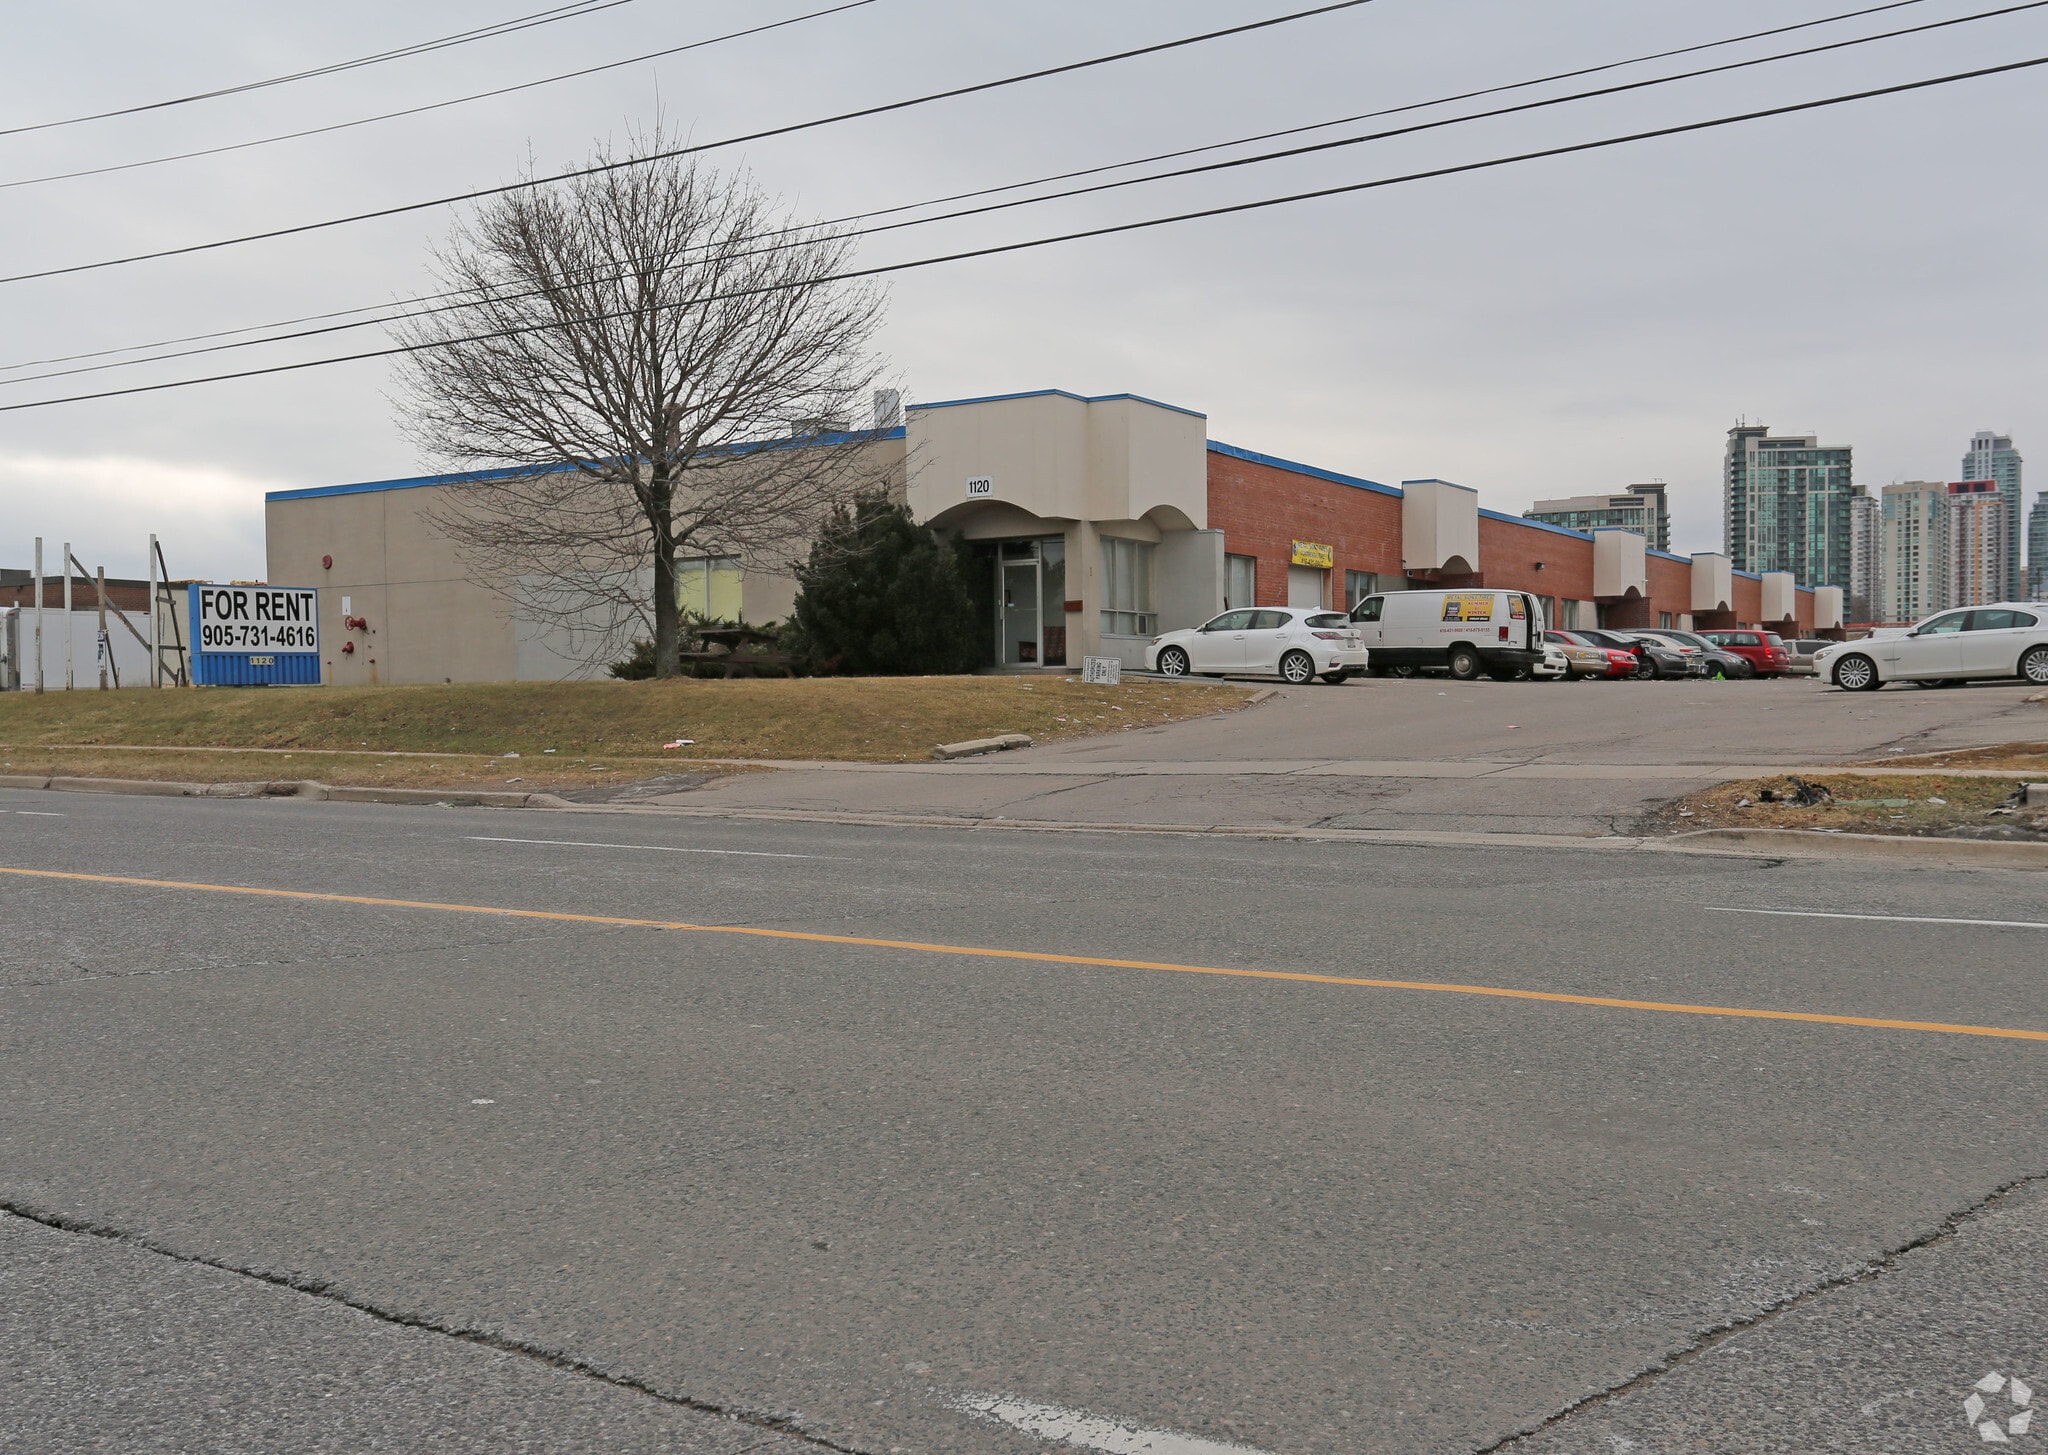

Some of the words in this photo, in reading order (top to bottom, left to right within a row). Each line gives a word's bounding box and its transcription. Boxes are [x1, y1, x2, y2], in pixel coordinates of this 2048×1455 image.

[969, 479, 990, 494] 1120
[201, 589, 249, 620] FOR
[255, 591, 313, 622] RENT
[202, 624, 315, 647] 905-731-4616
[250, 657, 274, 665] 1120
